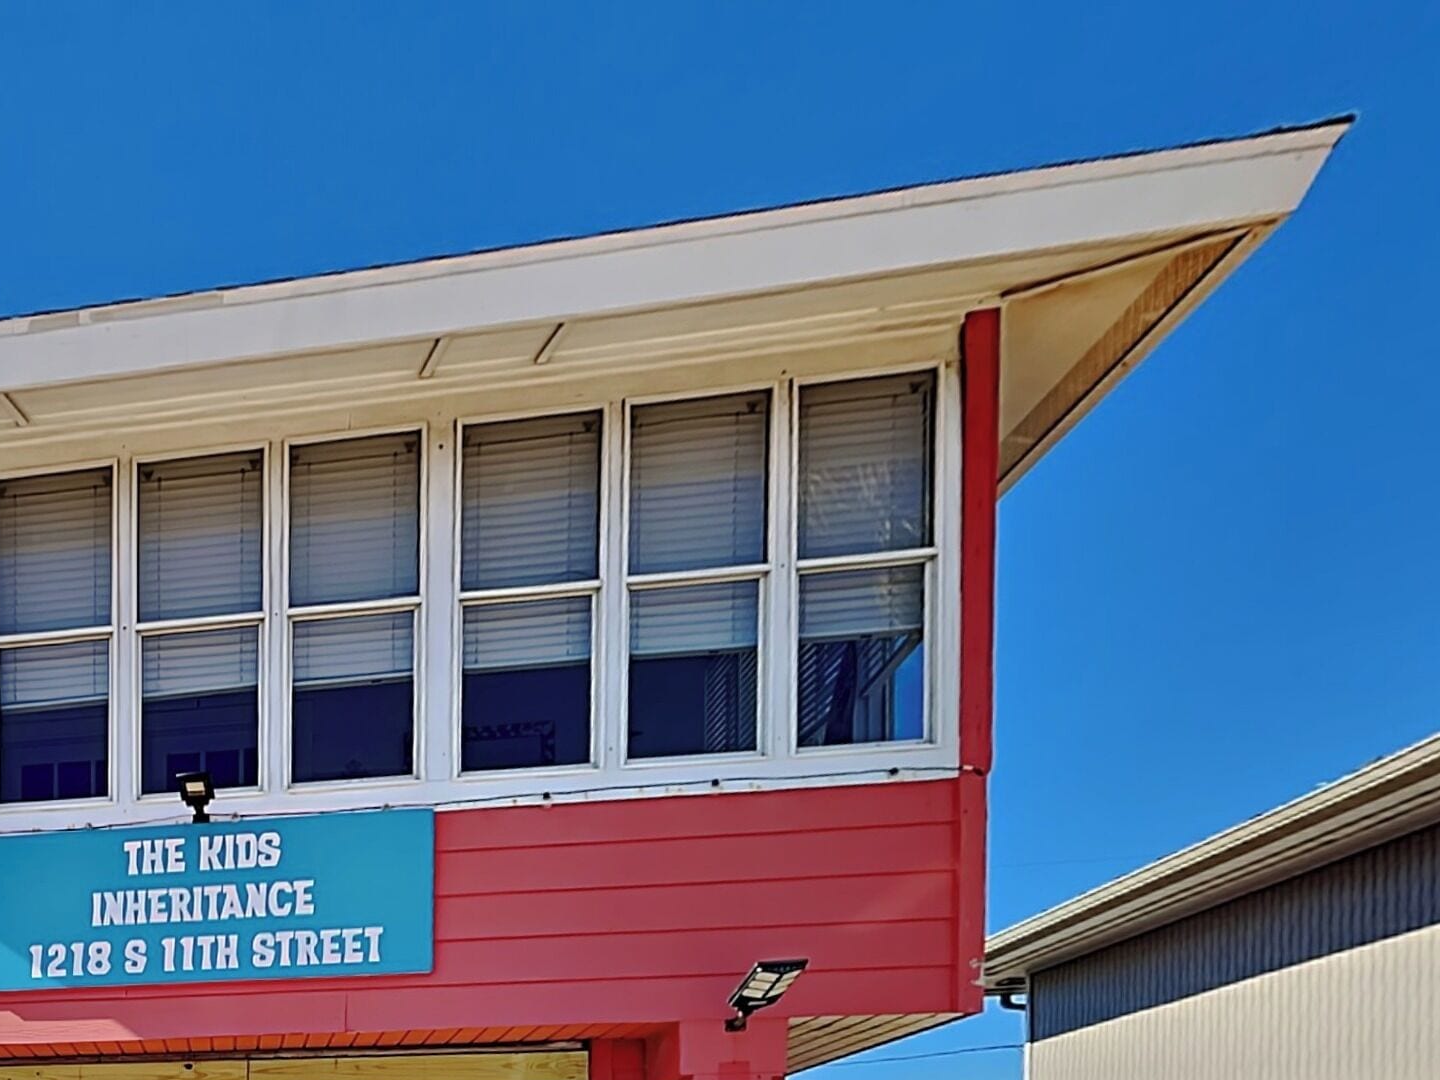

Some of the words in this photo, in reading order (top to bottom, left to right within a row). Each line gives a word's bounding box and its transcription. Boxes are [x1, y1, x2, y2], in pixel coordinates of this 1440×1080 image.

[123, 838, 186, 875] THE
[199, 831, 281, 871] KIDS
[92, 880, 315, 926] INHERITANCE
[29, 941, 112, 978] 1218
[124, 939, 147, 974] S
[161, 934, 240, 973] 11TH
[252, 927, 383, 967] STREET
